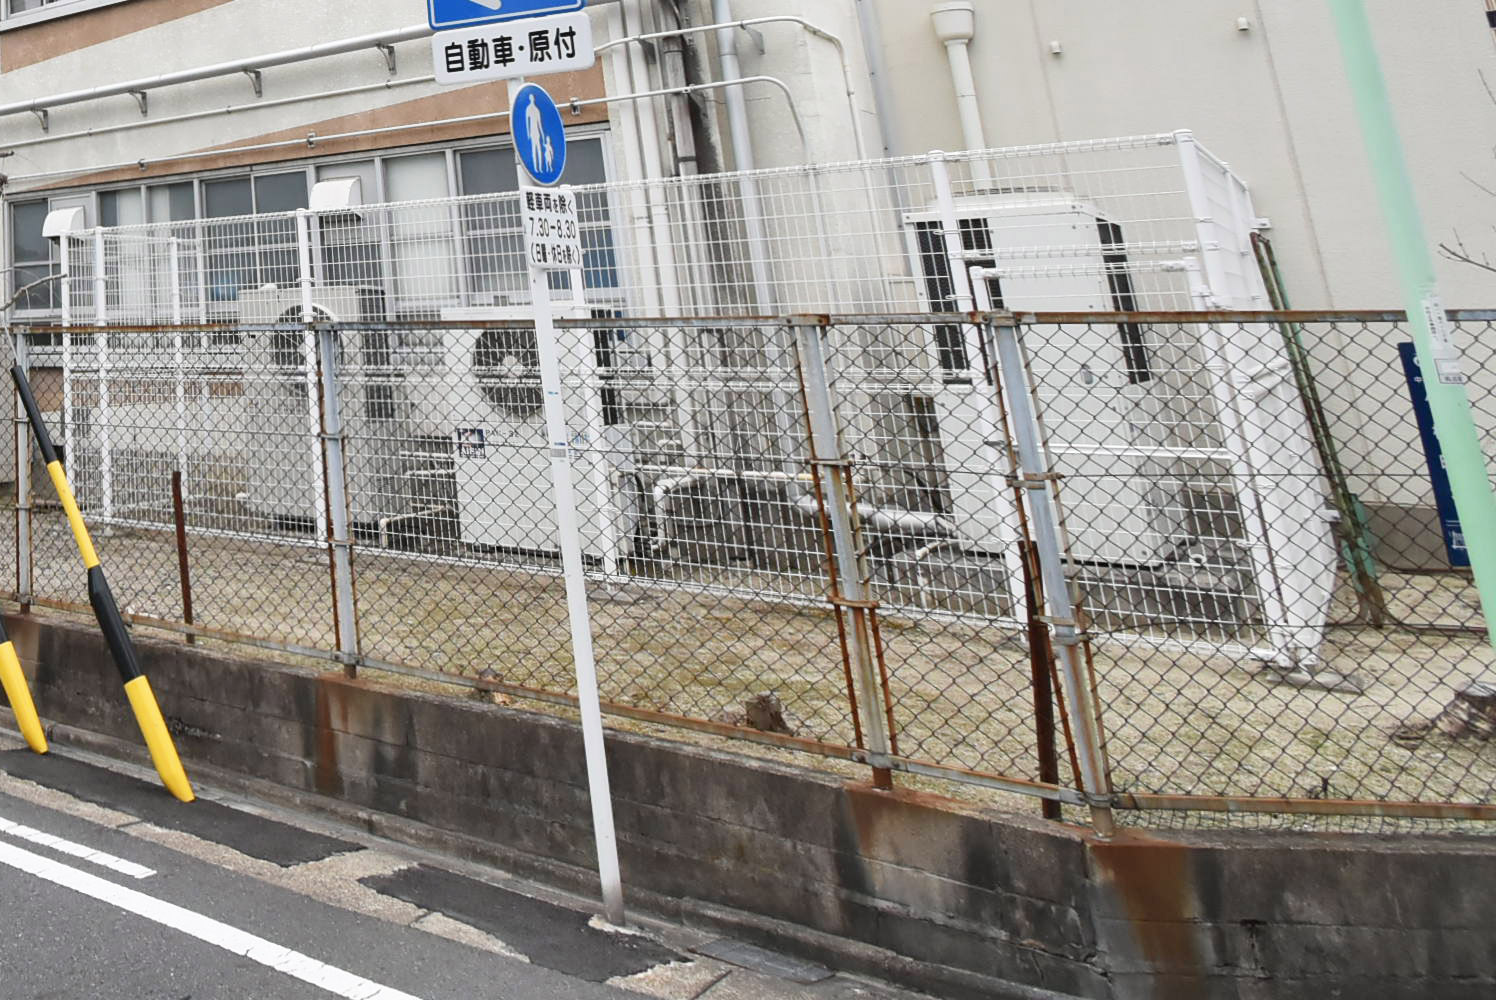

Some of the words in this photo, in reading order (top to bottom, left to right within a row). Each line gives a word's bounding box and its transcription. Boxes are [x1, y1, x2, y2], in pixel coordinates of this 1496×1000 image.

[444, 25, 577, 73] 自動車・原付
[526, 191, 573, 214] 軽車両を除く
[529, 217, 576, 239] 7.30-8.30
